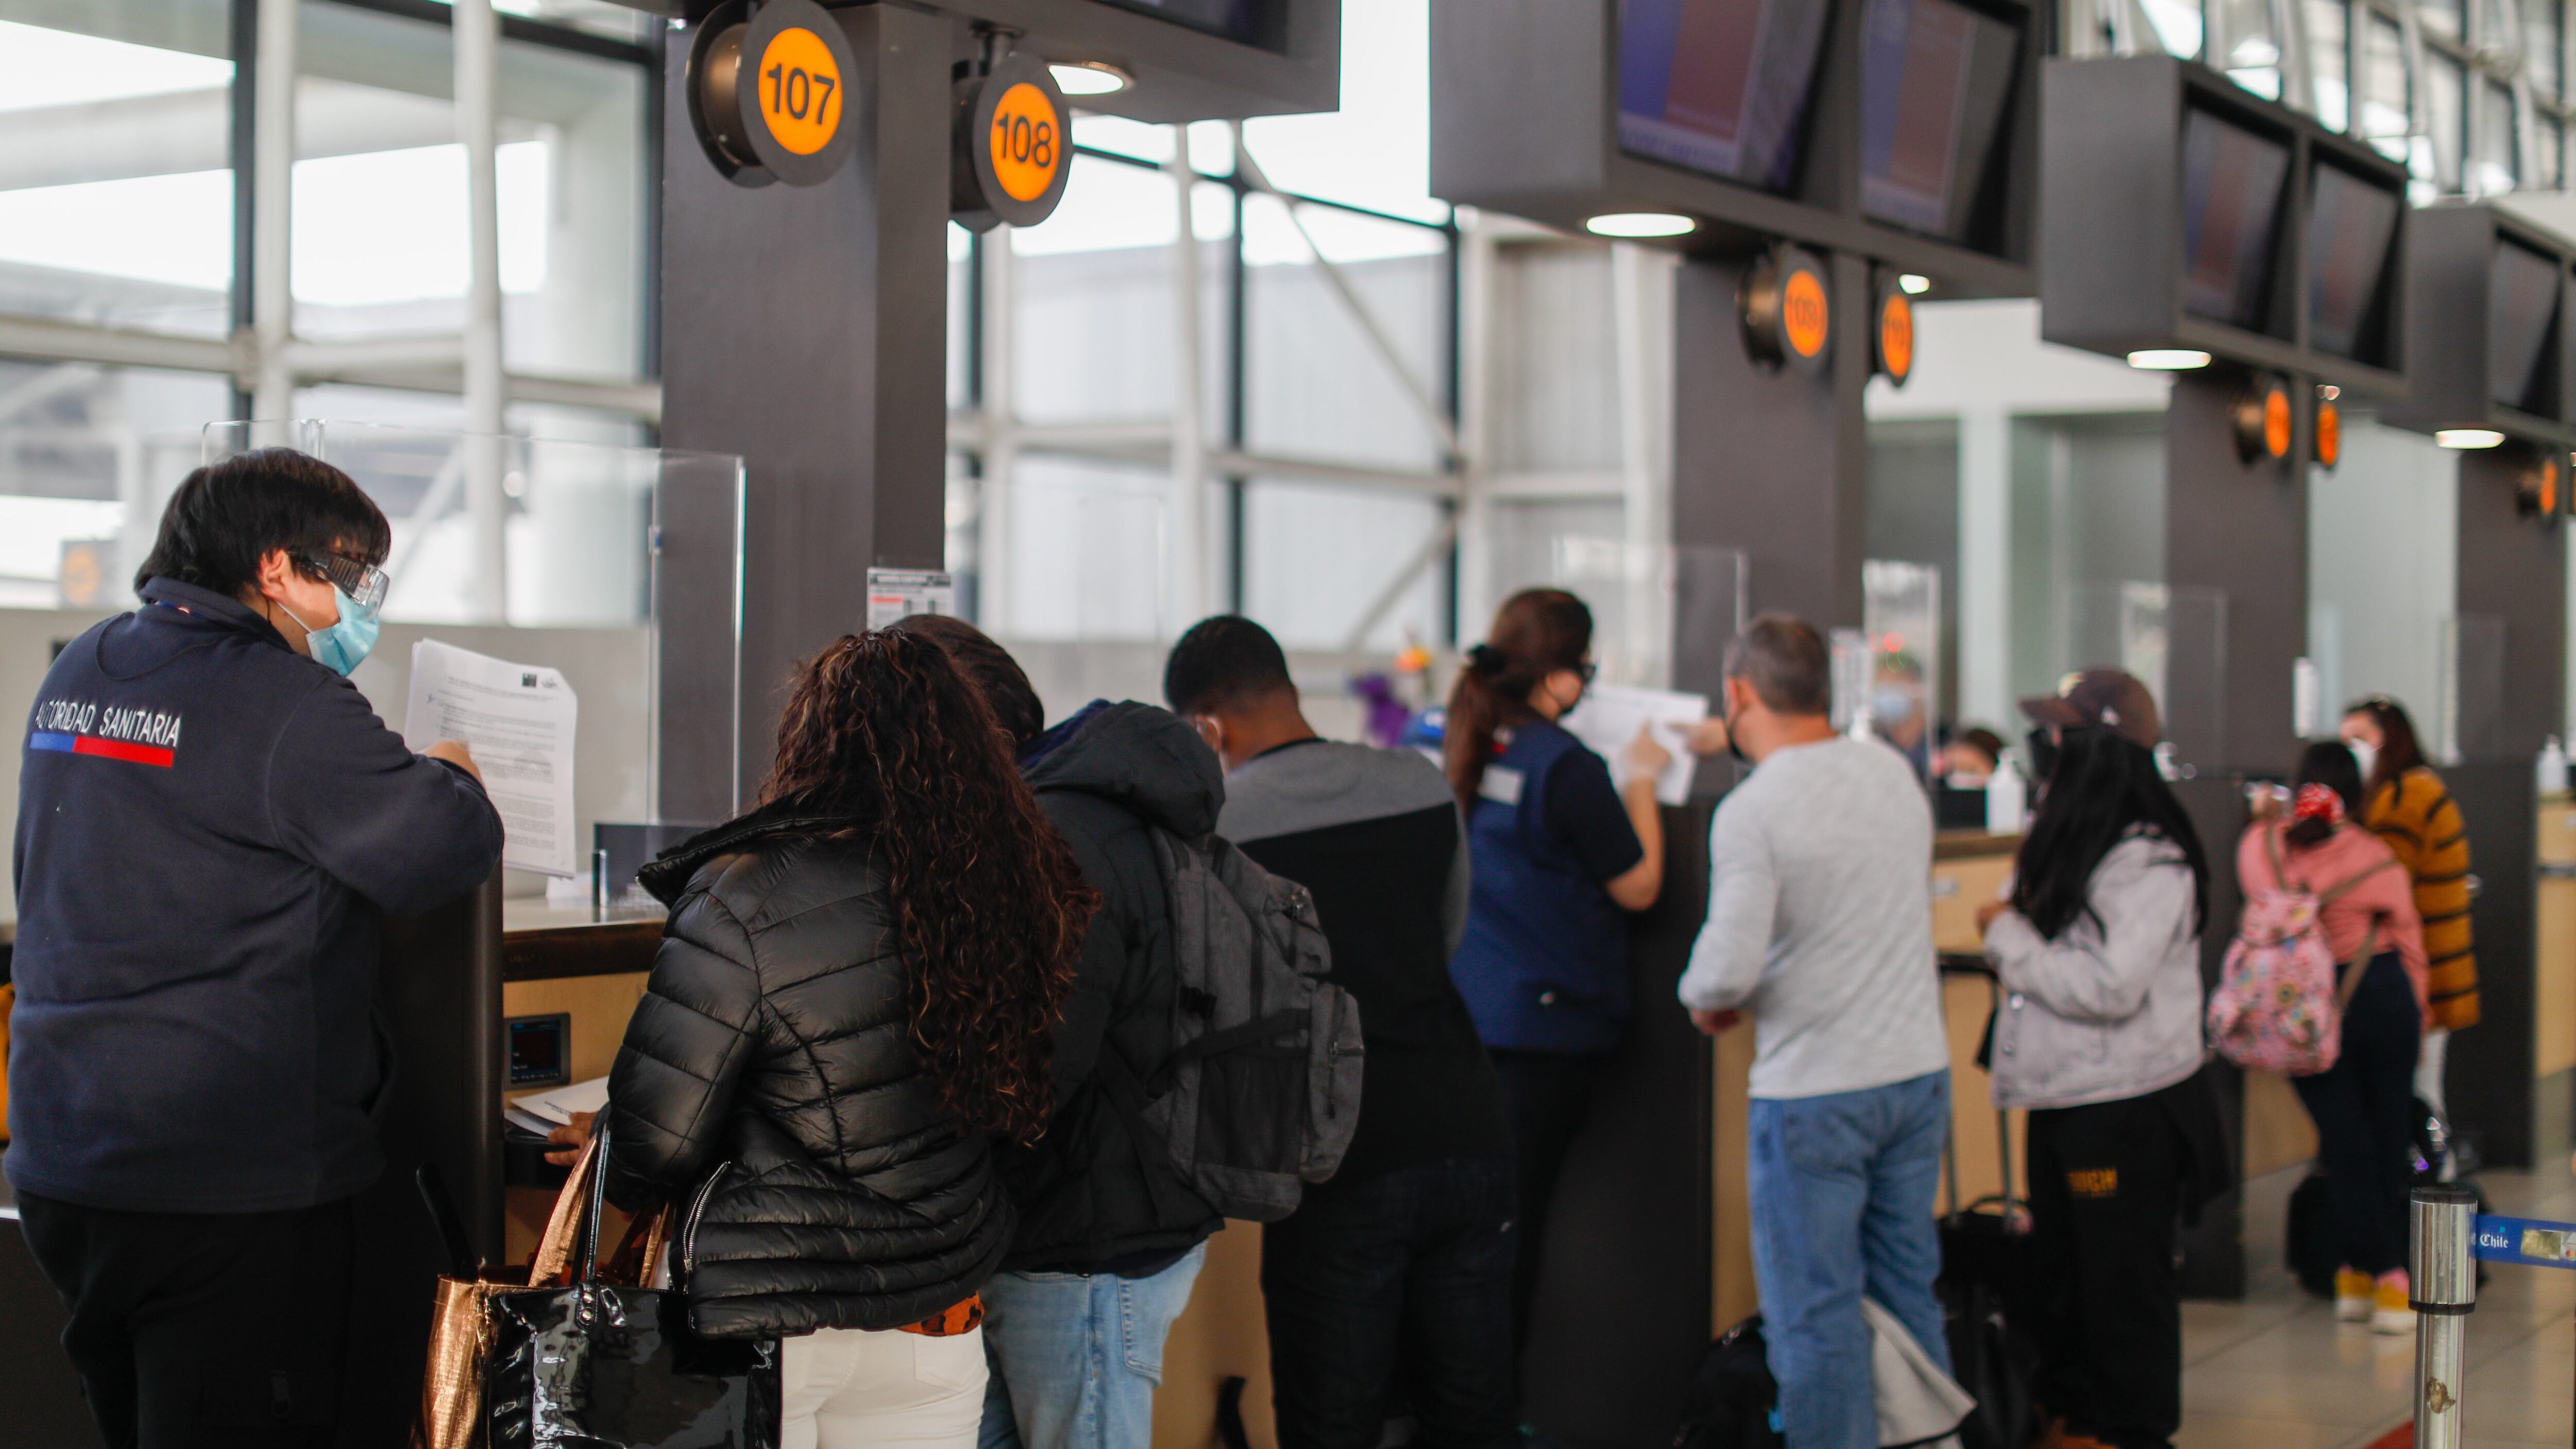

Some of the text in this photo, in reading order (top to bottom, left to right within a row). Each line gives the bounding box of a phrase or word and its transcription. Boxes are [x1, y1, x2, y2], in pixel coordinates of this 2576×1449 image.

[767, 63, 835, 124] 107
[996, 112, 1052, 167] 108
[99, 706, 181, 747] SANITARIA
[2480, 1234, 2509, 1248] Chile
